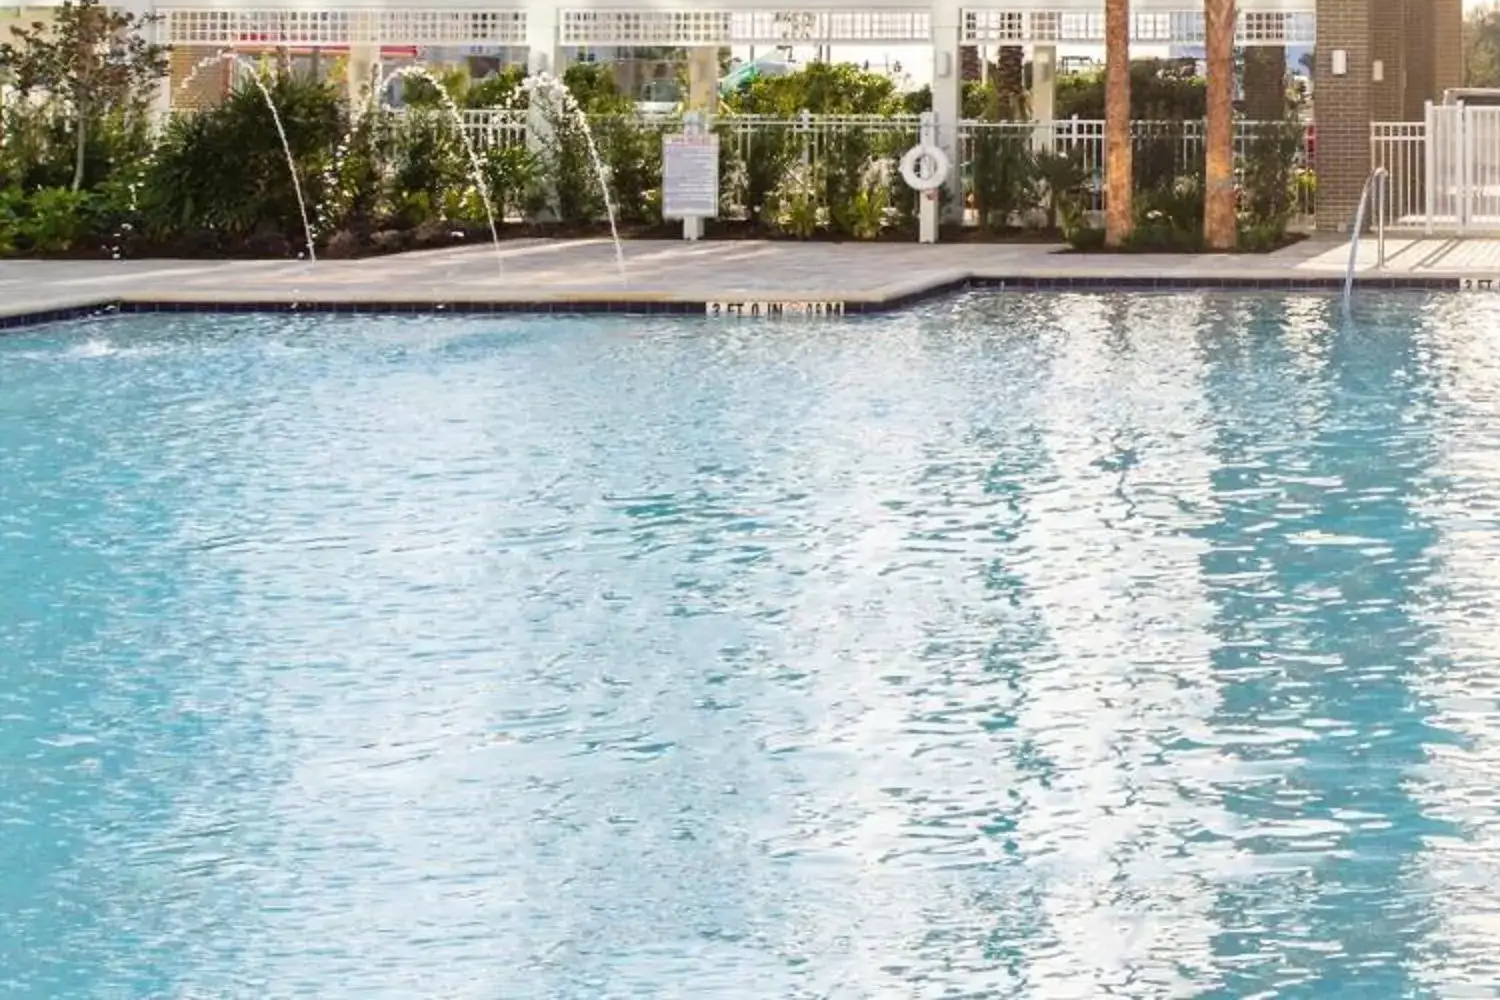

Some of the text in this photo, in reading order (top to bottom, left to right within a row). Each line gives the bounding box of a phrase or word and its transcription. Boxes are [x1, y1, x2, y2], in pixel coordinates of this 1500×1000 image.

[1478, 279, 1492, 290] FT
[727, 303, 744, 315] FT
[767, 303, 782, 316] IN
